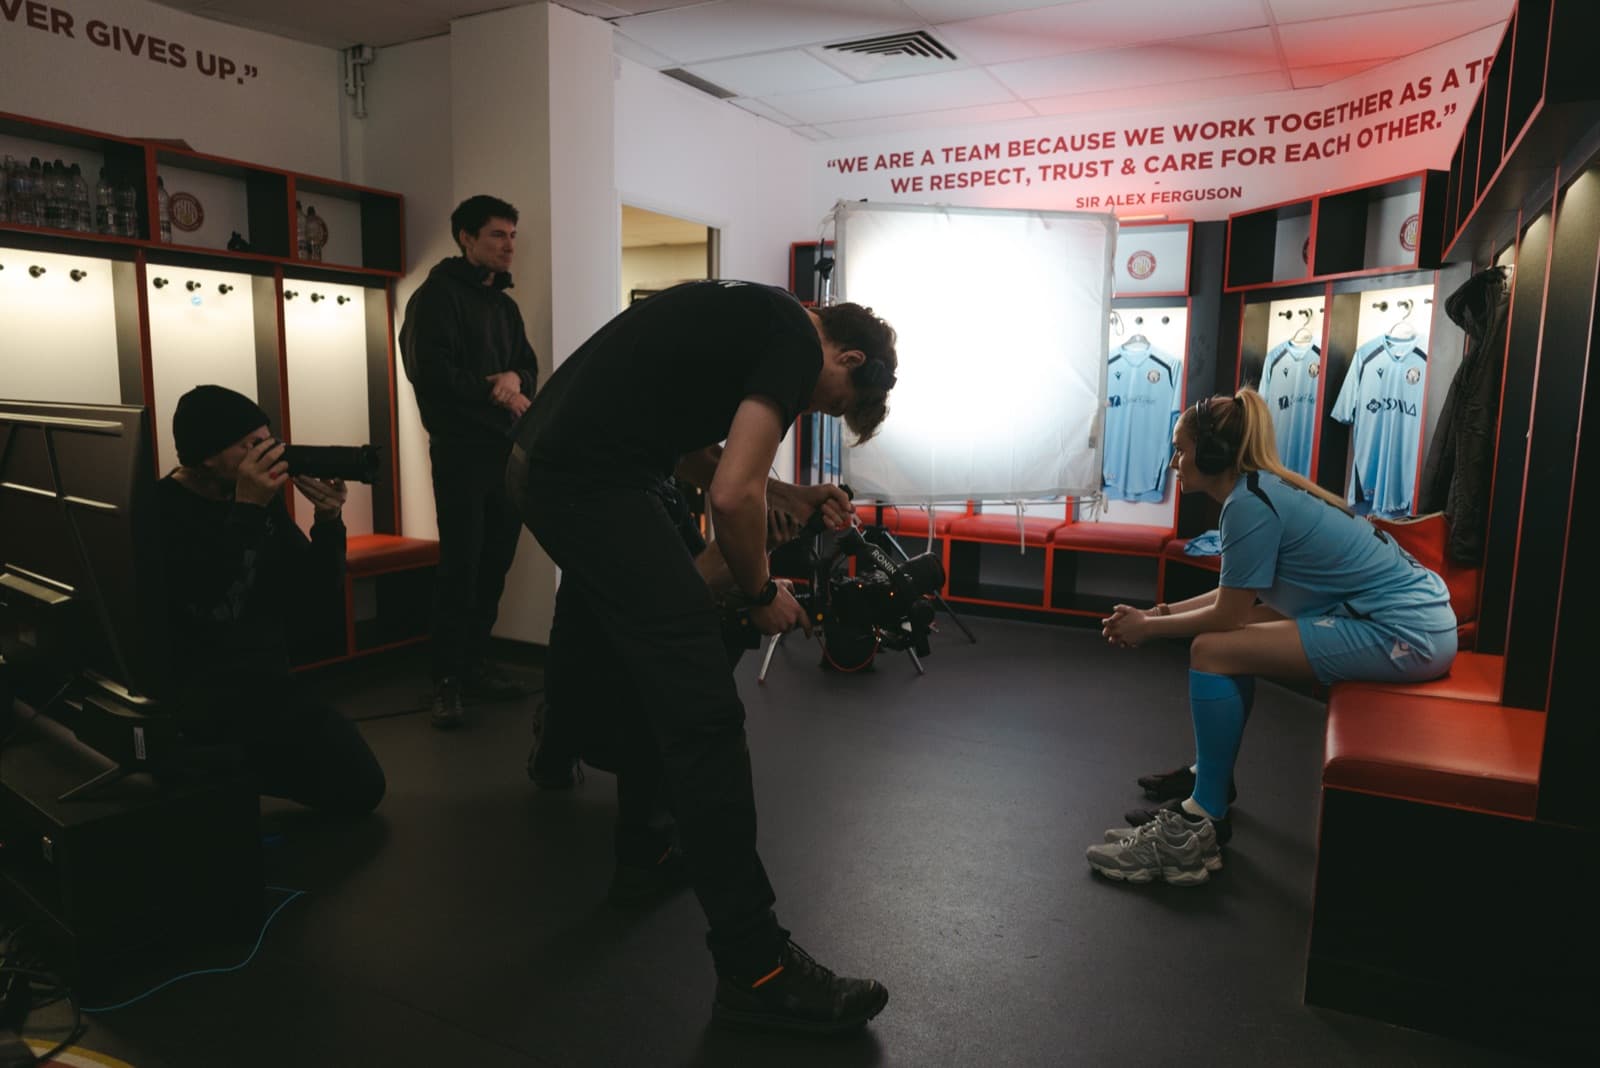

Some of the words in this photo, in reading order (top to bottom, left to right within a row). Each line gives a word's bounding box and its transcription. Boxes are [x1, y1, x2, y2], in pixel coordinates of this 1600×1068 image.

[86, 20, 187, 68] GIVES
[196, 50, 258, 85] UP.”
[827, 157, 868, 174] “WE
[874, 150, 914, 170] ARE
[921, 150, 935, 165] A
[942, 143, 1000, 163] TEAM
[1008, 132, 1115, 157] BECAUSE
[1124, 128, 1164, 147] WE
[1173, 118, 1255, 142] WORK
[1264, 89, 1393, 134] TOGETHER
[1399, 76, 1431, 105] AS
[1441, 68, 1459, 92] A
[891, 177, 923, 193] WE
[930, 167, 1031, 190] RESPECT,
[1038, 159, 1114, 182] TRUST
[1121, 158, 1136, 175] &
[1144, 151, 1213, 174] CARE
[1221, 145, 1276, 168] FOR
[1285, 134, 1350, 162] EACH
[1357, 103, 1456, 149] OTHER.”
[1076, 197, 1099, 208] SIR
[1105, 193, 1145, 207] ALEX
[1152, 187, 1242, 203] FERGUSON
[871, 550, 897, 574] RONIN
